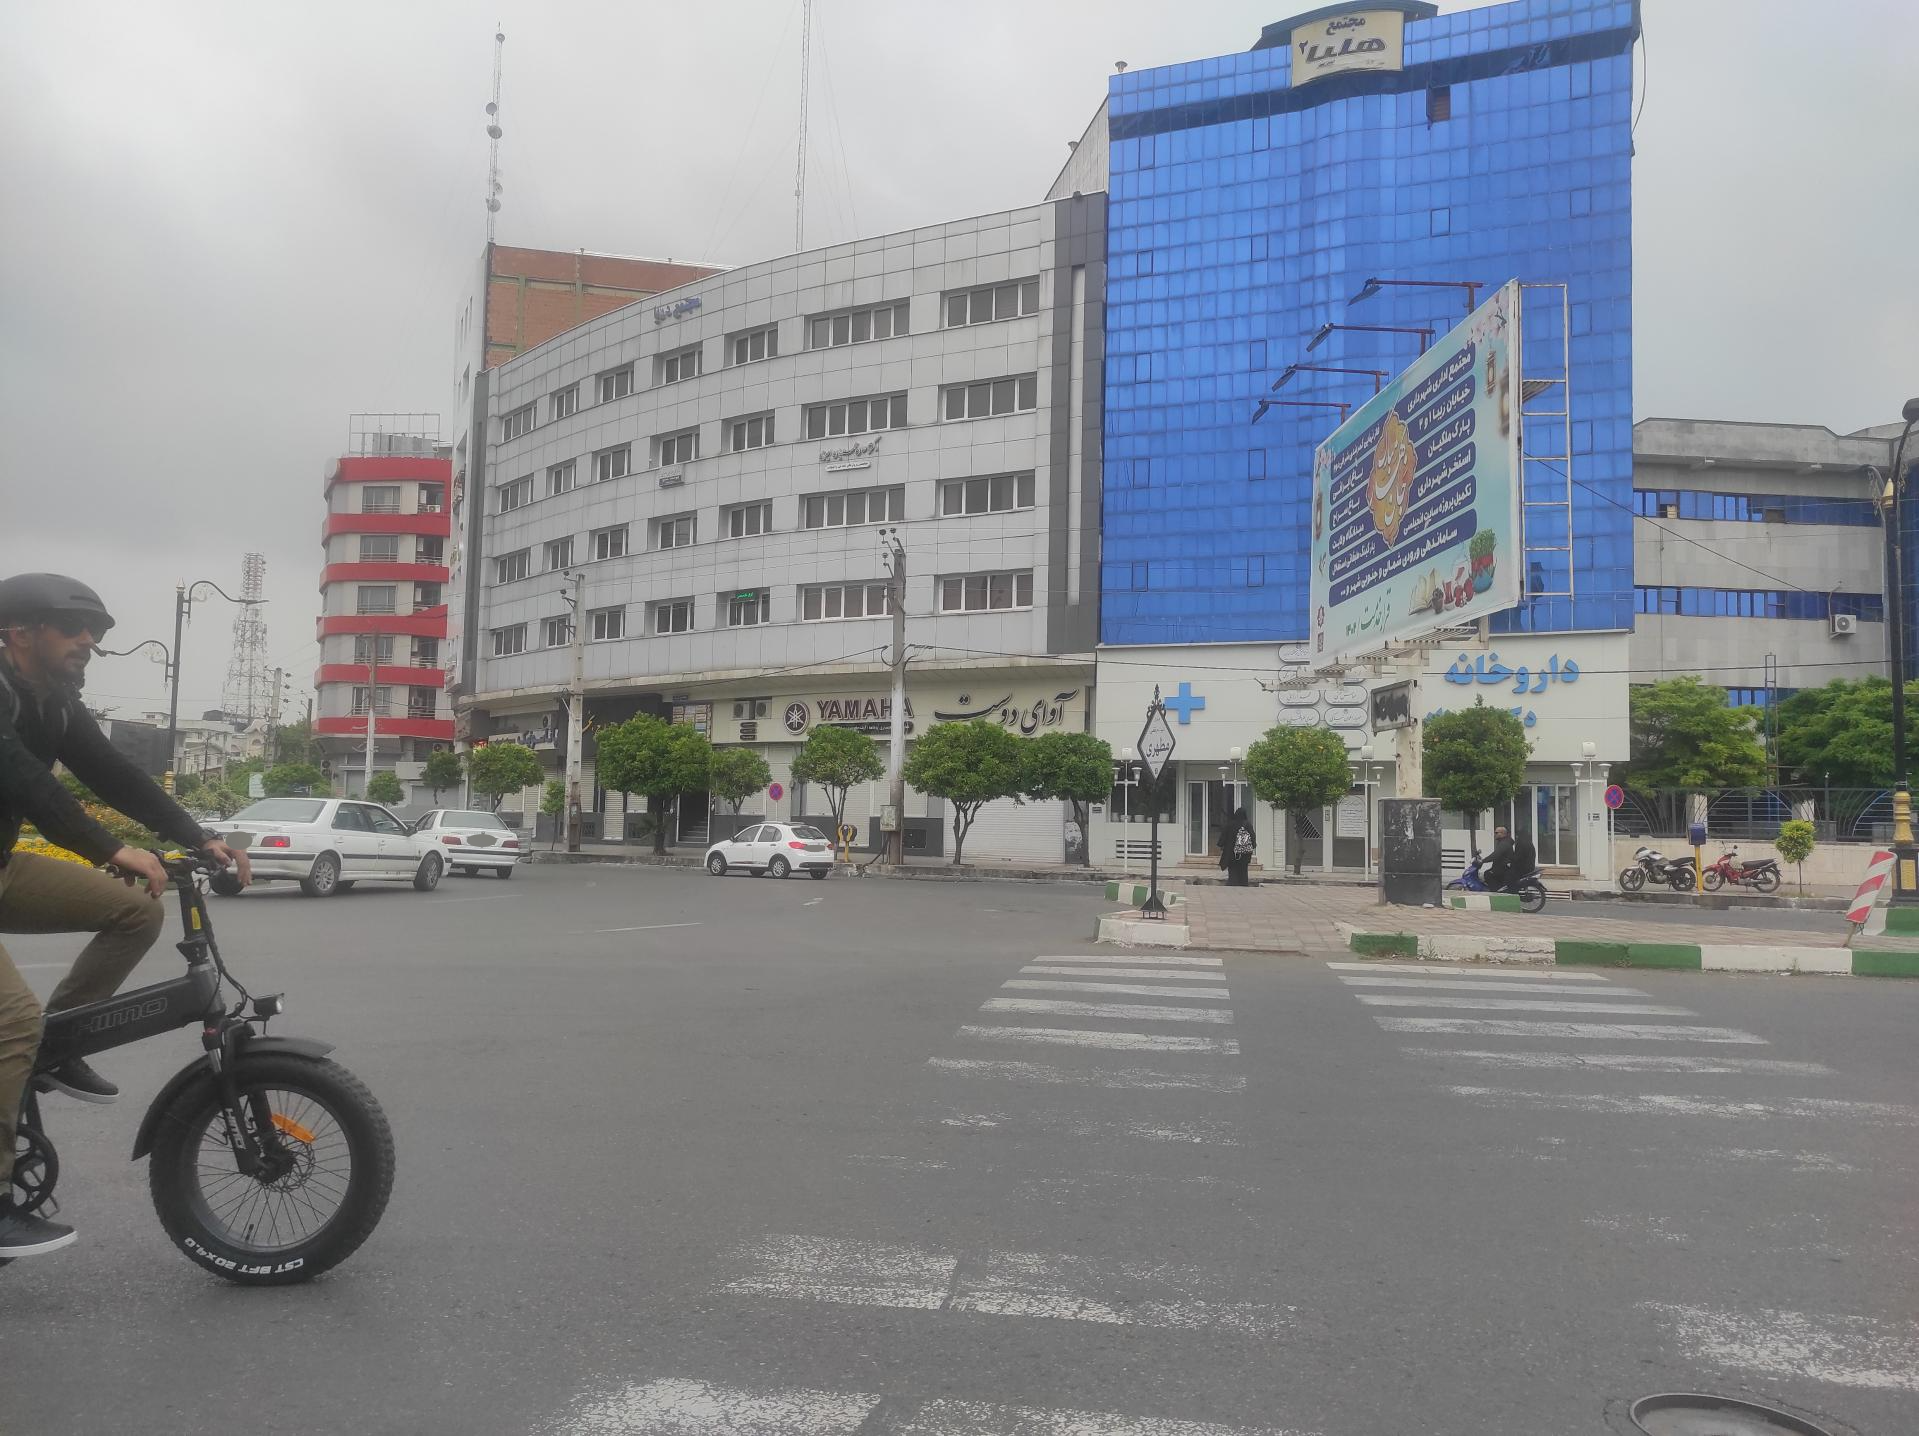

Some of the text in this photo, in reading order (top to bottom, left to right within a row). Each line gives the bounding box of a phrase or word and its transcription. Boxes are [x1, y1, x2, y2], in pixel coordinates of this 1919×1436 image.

[1326, 16, 1366, 35] مجتمع
[1448, 352, 1471, 382] مجتمع
[1408, 378, 1432, 413] شهرداری
[1446, 383, 1471, 413] خیابان
[1451, 418, 1471, 439] پارک
[1417, 449, 1471, 497] استخر شهرداری
[1439, 496, 1454, 514] پروژه
[1453, 482, 1472, 507] تکمیل
[1420, 528, 1458, 557] ساماندهی
[1382, 552, 1402, 577] شمالی
[1402, 547, 1421, 568] ورودی
[1361, 568, 1379, 588] جنوبی
[1444, 652, 1580, 694] داروخانه
[934, 688, 1080, 735] آوای دوست
[184, 1237, 304, 1275] CST BFT 20x4.0
